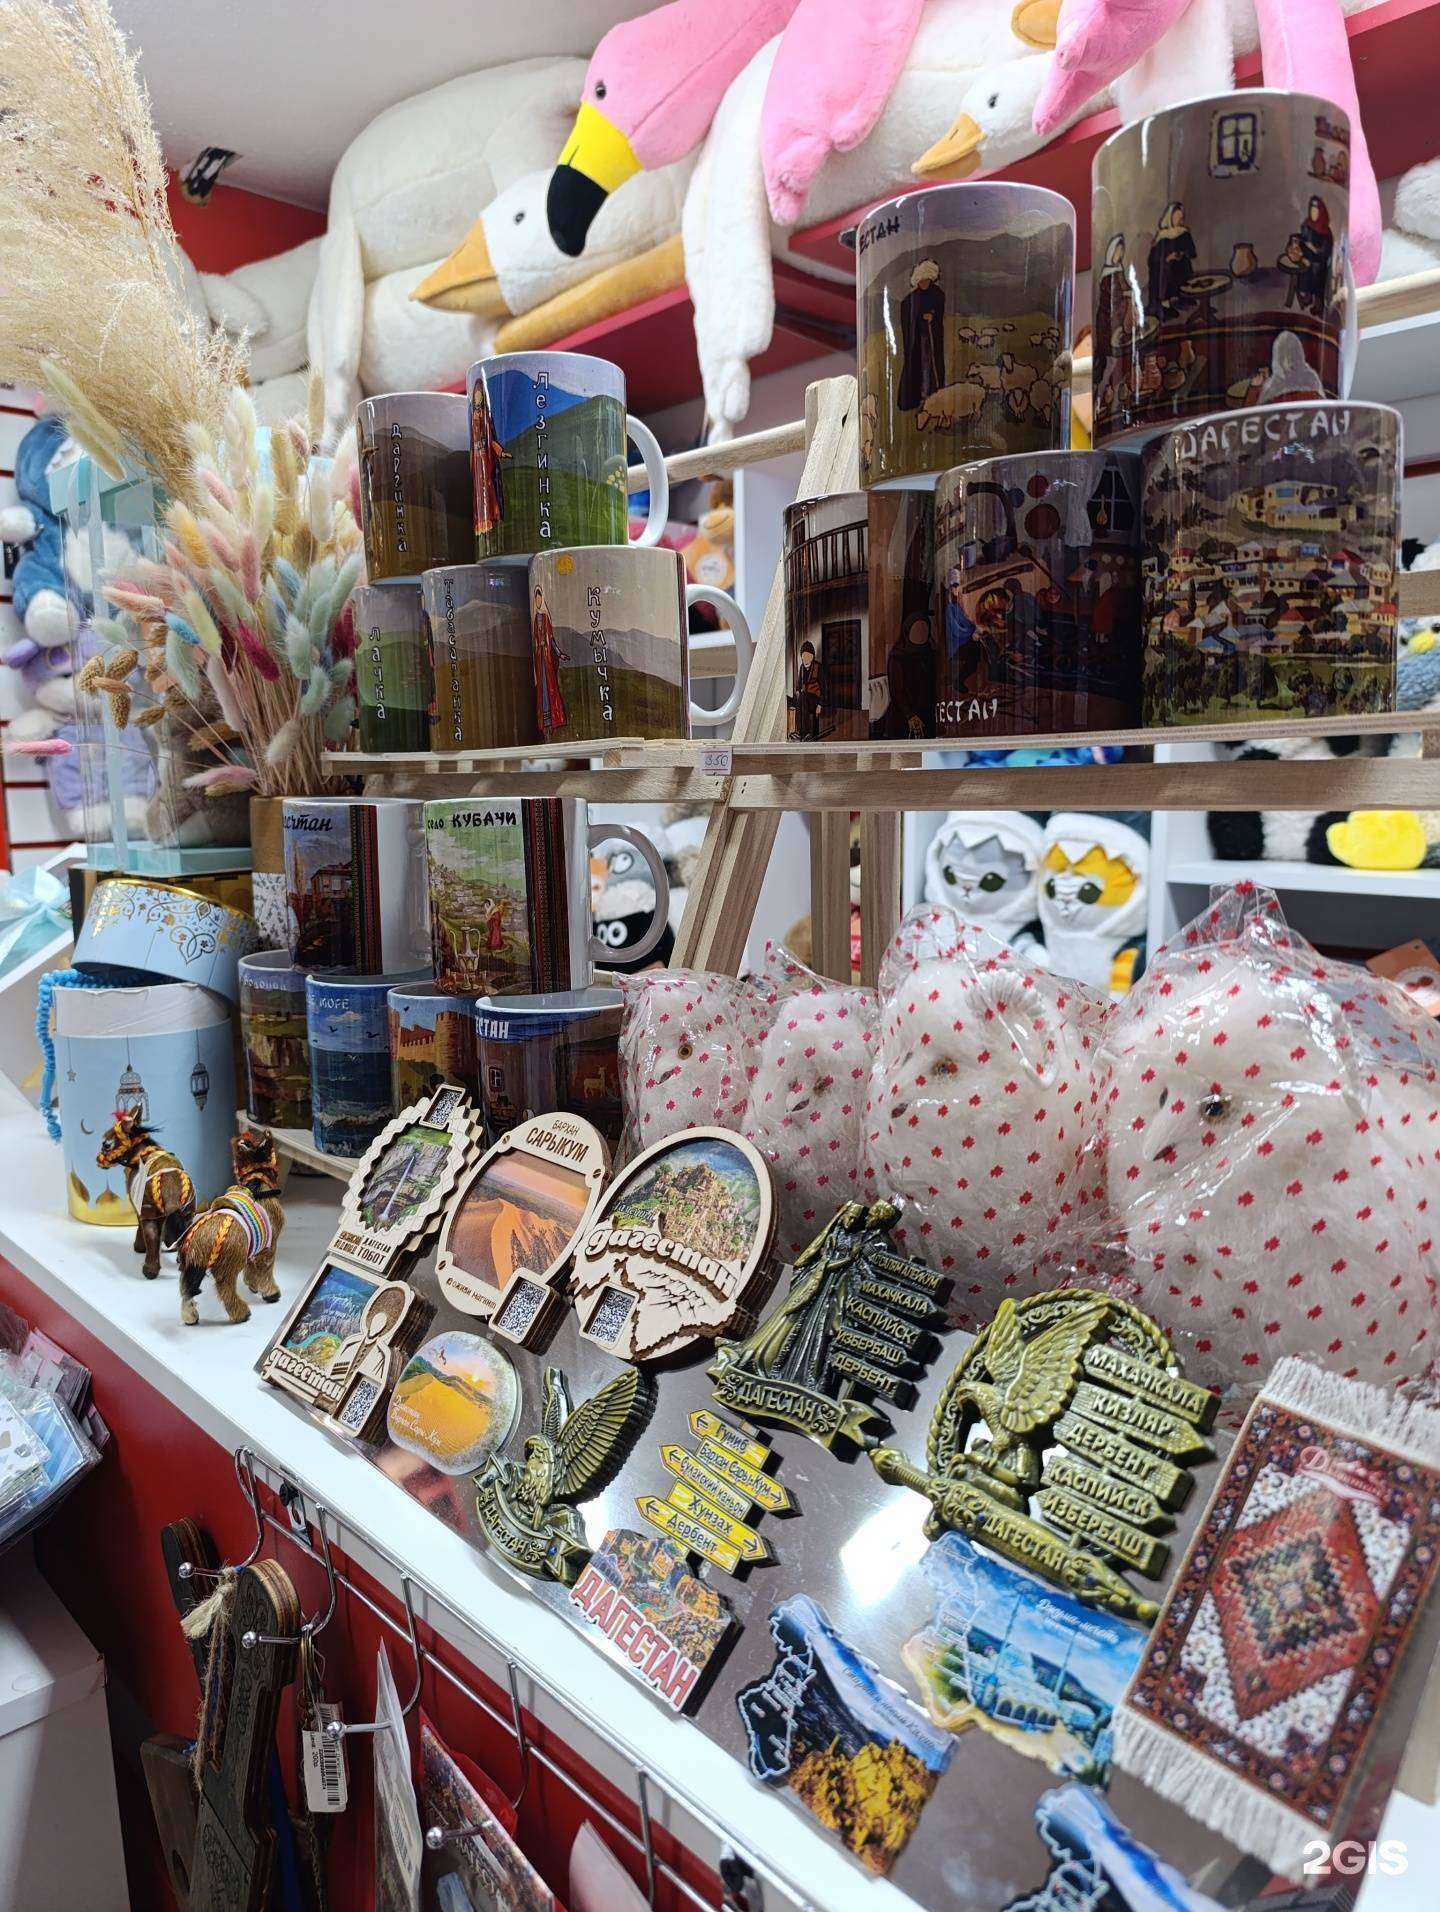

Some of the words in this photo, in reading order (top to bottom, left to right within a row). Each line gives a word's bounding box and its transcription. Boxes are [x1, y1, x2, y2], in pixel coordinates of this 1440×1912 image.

[532, 371, 551, 539] Лезгинка
[369, 626, 386, 720] Лачка
[587, 586, 613, 721] Кумычка
[452, 811, 517, 828] КУБАЧИ
[526, 1127, 590, 1163] САРЫКУМ
[552, 1119, 580, 1136] БАРХАН
[357, 1246, 386, 1266] ТОБОТ
[860, 1281, 928, 1313] МАХАЧКАЛА
[847, 1296, 915, 1344] КАСПИЙСК
[836, 1330, 900, 1363] ИЗБЕРБАШ
[832, 1355, 892, 1392] ДЕРБЕНТ
[1089, 1349, 1201, 1413] МАХАЧКАЛА
[737, 1381, 819, 1422] ДАГЕСТАН
[1092, 1394, 1173, 1437] КИЗЛЯР
[699, 1443, 730, 1470] Бархан
[715, 1422, 749, 1453] Гуниб
[1066, 1422, 1154, 1479] ДЕРБЕНТ
[680, 1456, 719, 1495] Сулакский
[717, 1487, 744, 1517] каньон
[1049, 1462, 1150, 1518] КАСПИЙСК
[484, 1503, 529, 1553] ДАГЕСТАН
[667, 1513, 717, 1553] Дербент
[688, 1495, 733, 1534] Хунзах
[1044, 1492, 1143, 1556] ИЗБЕРБАШ
[982, 1514, 1067, 1572] ДАГЕСТАН
[570, 1569, 699, 1709] ДАГЕСТАН
